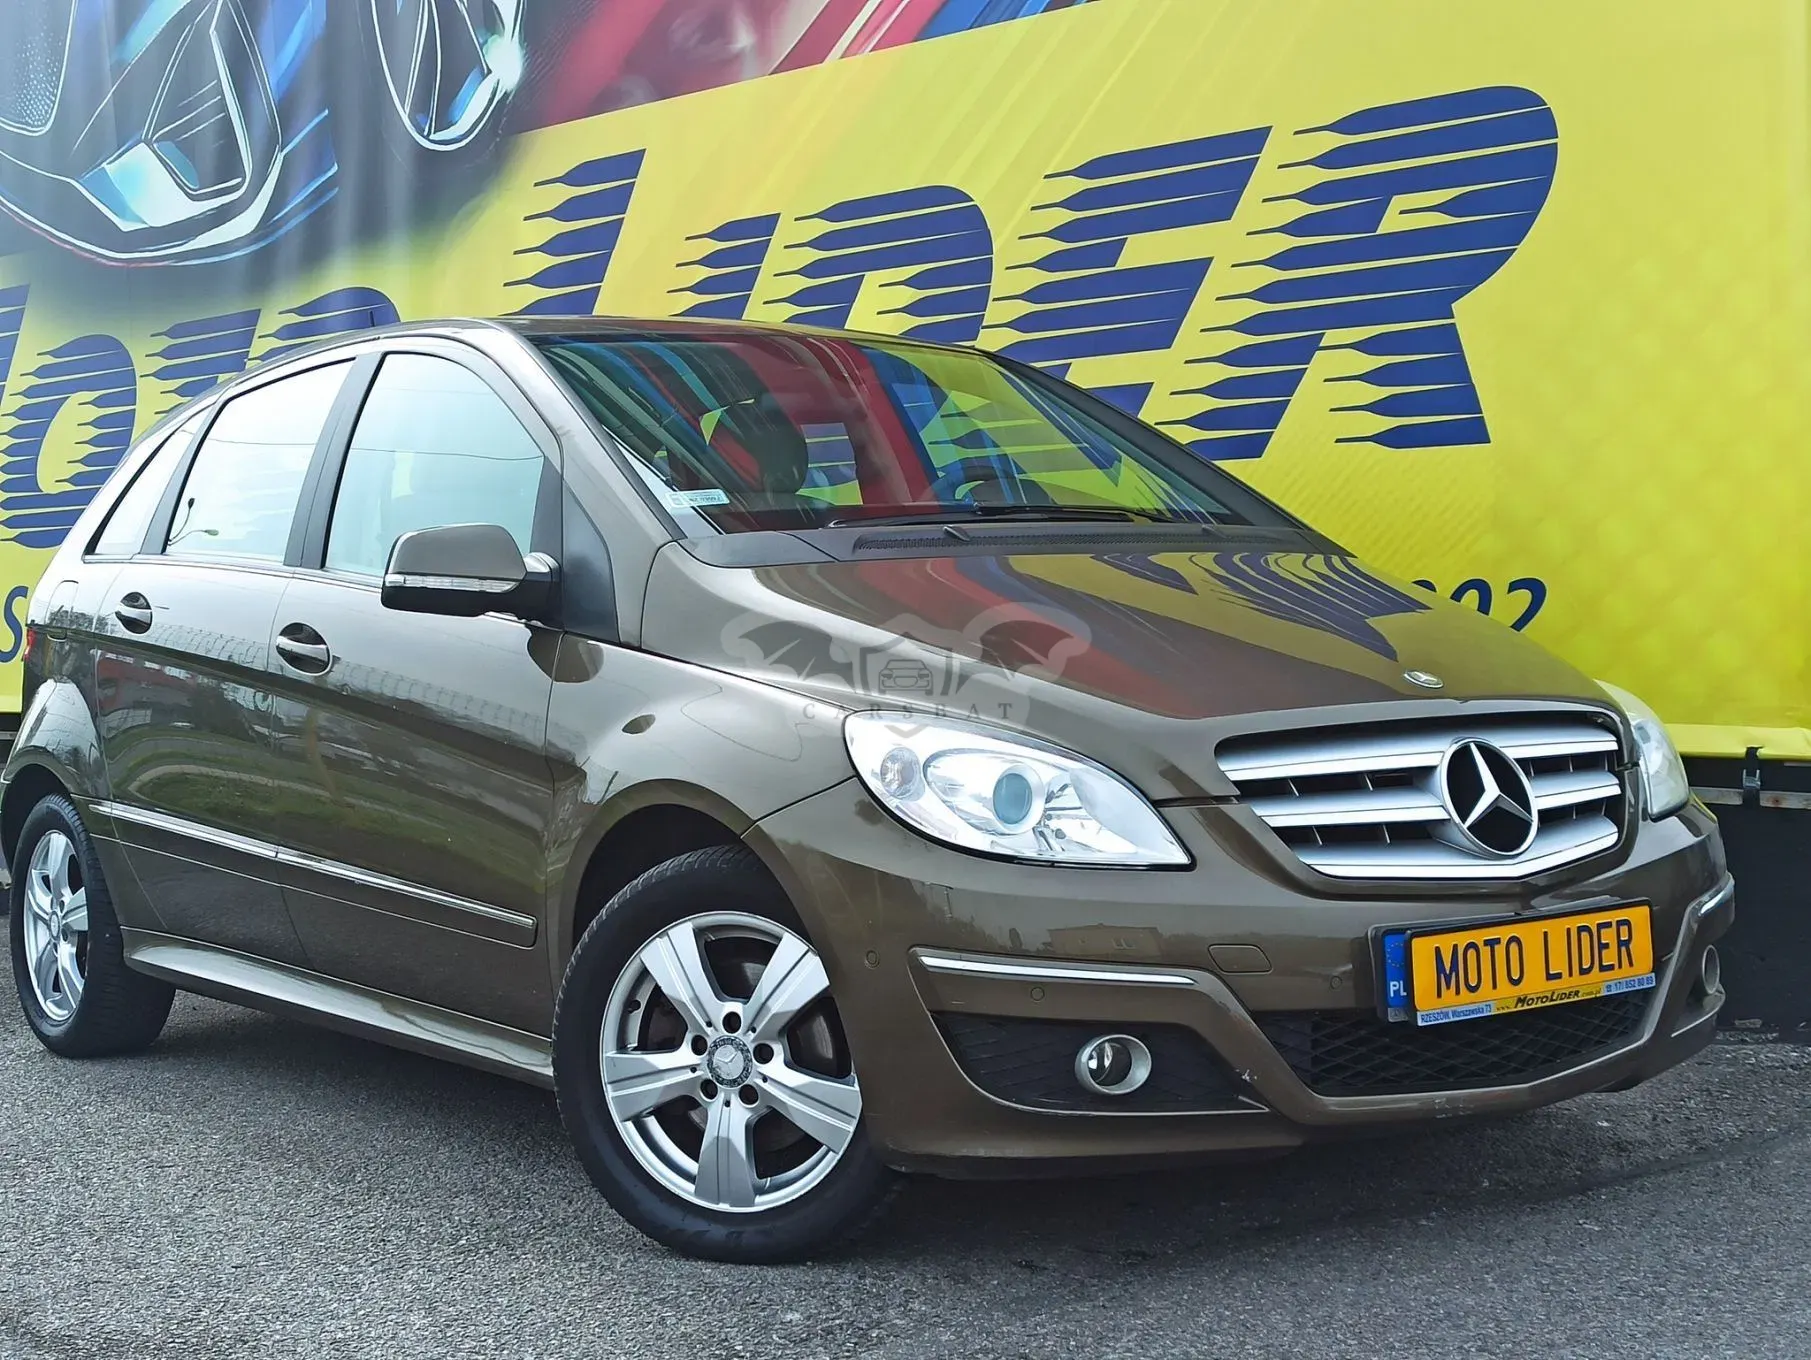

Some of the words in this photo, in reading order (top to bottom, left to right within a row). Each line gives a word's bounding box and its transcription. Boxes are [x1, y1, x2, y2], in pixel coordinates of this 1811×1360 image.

[1434, 935, 1524, 999] MOTO
[1543, 918, 1635, 982] LIDER
[1389, 980, 1407, 998] PL
